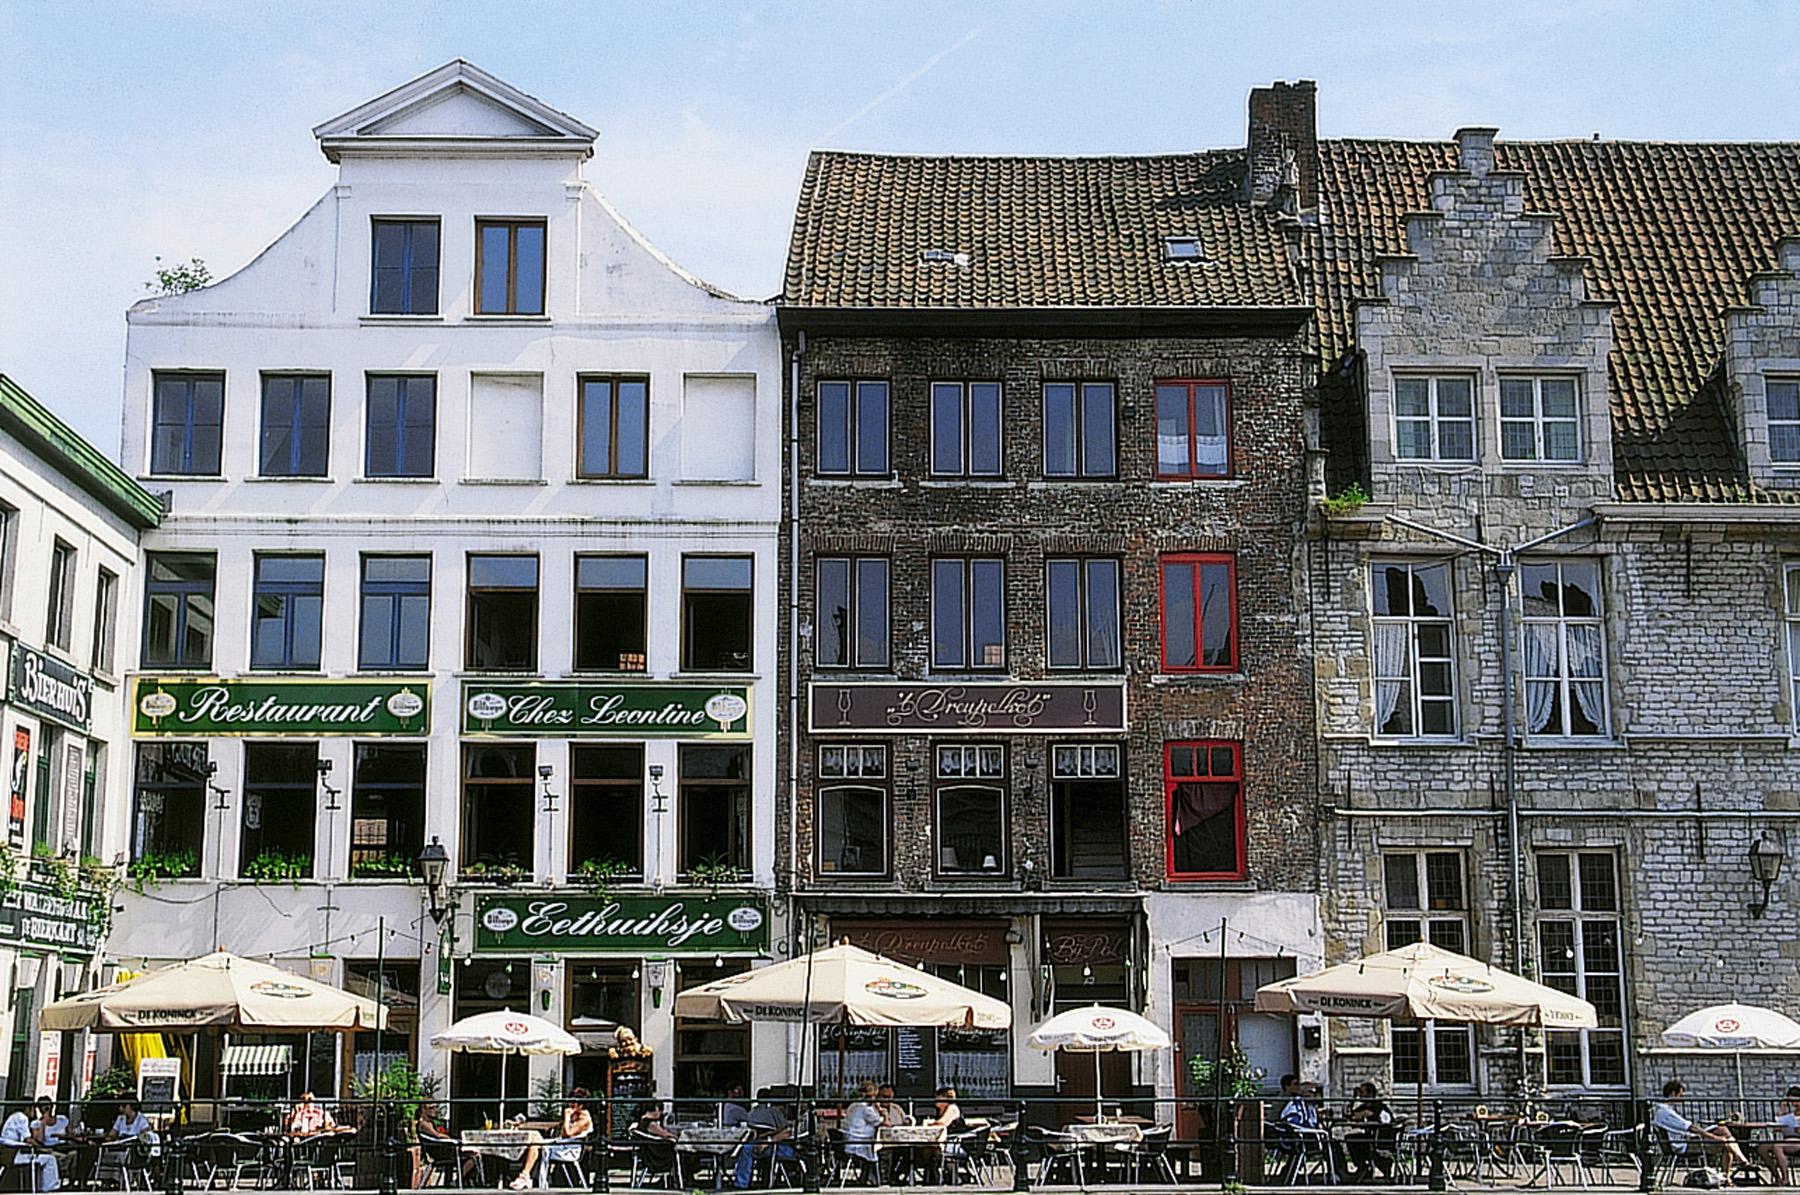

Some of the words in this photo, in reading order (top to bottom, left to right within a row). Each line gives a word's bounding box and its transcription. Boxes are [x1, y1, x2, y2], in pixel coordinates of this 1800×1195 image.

[178, 686, 382, 722] Restaurant
[507, 694, 574, 724] Chez
[580, 694, 706, 724] Leontine
[1333, 996, 1372, 1009] KONINCK
[152, 1009, 196, 1020] KONINCK
[768, 1005, 804, 1017] KONINC
